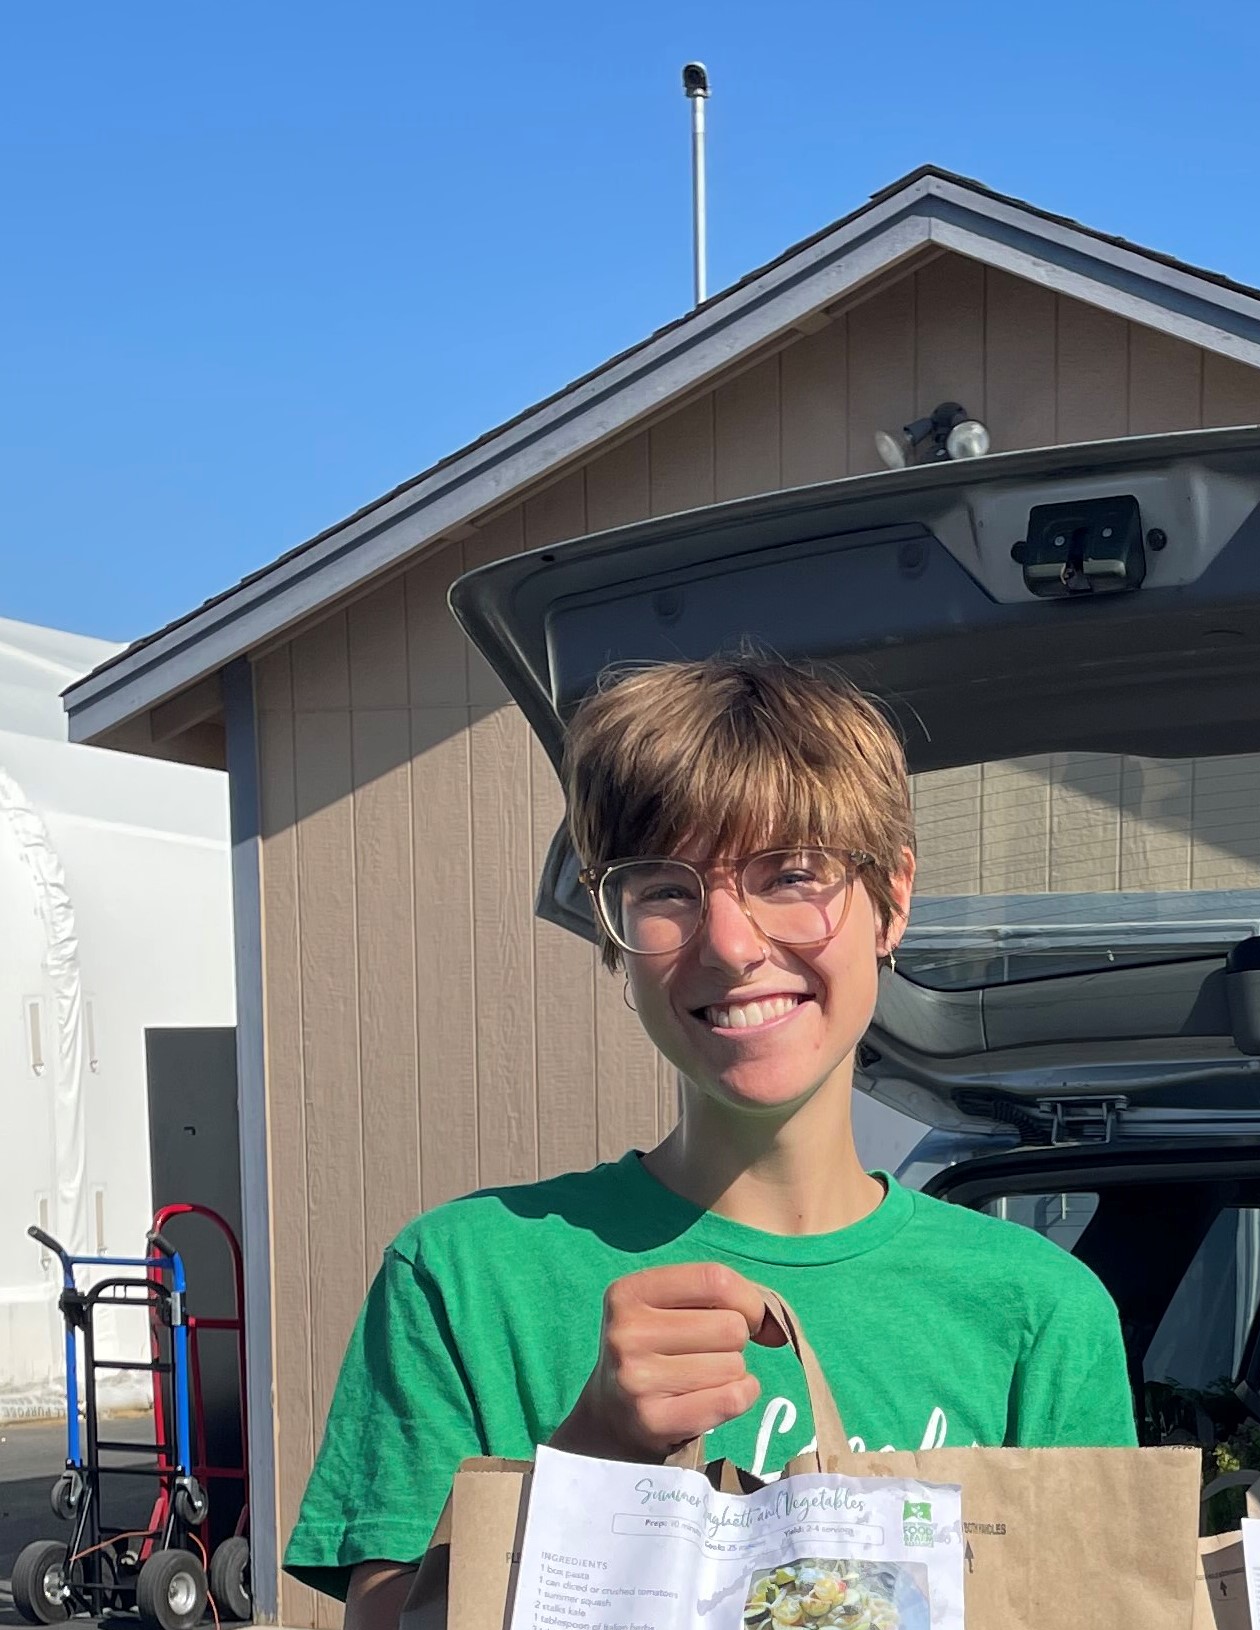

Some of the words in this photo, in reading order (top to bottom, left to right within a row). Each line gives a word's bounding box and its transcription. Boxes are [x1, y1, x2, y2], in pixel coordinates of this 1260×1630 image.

[635, 1478, 701, 1507] Summer
[779, 1487, 865, 1521] Vegetables
[541, 1551, 608, 1570] INGREDIENTS
[547, 1565, 563, 1575] box
[565, 1570, 590, 1580] pasta
[545, 1579, 560, 1587] can
[563, 1582, 588, 1592] diced
[602, 1587, 635, 1596] crushed
[638, 1588, 678, 1599] tomatoes
[544, 1591, 579, 1604] summer
[581, 1598, 611, 1608] squash
[535, 1600, 540, 1609] 2
[542, 1604, 565, 1614] stalks
[568, 1606, 586, 1617] kale
[541, 1615, 590, 1630] tablespoon
[592, 1623, 602, 1630] of
